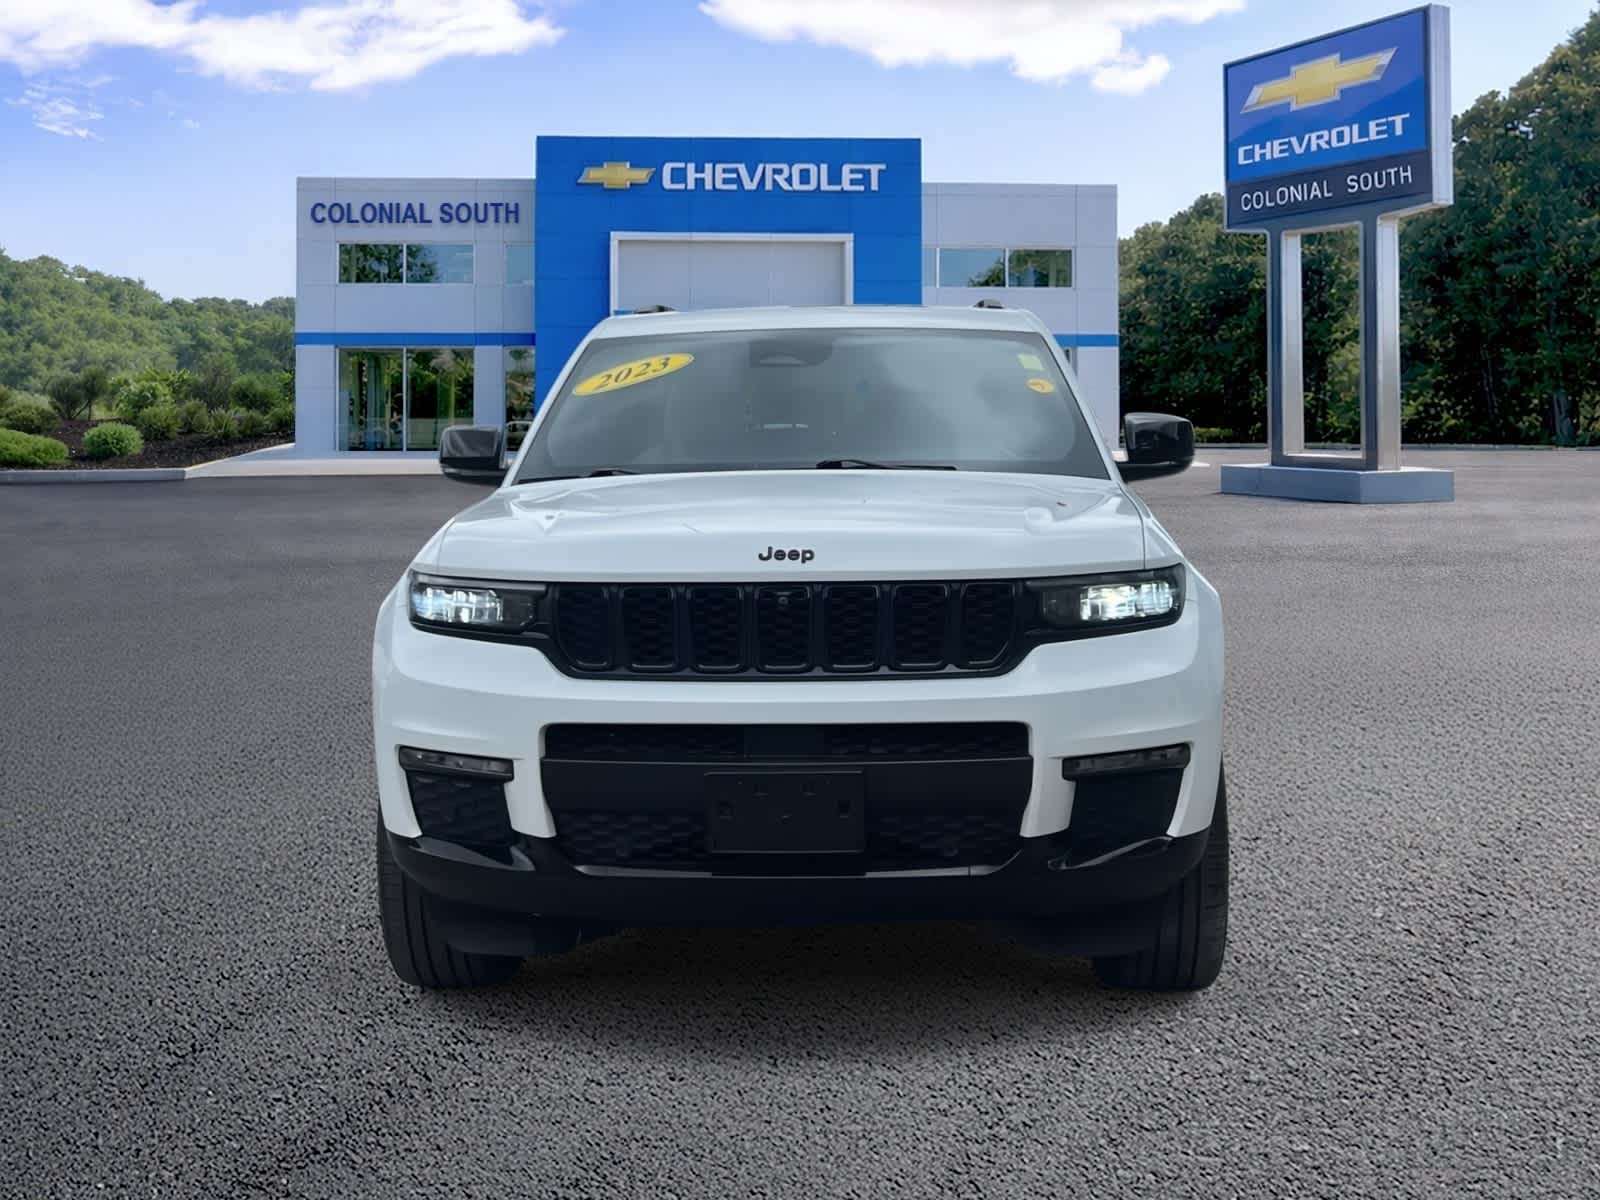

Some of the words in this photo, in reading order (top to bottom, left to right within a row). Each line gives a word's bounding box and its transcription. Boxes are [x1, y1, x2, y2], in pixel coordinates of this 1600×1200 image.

[1238, 114, 1409, 165] CHEVROLET
[661, 162, 886, 192] CHEVROLET
[1241, 180, 1333, 211] COLONIAL
[1346, 165, 1413, 193] SOUTH
[310, 202, 433, 225] COLONIAL
[439, 202, 521, 225] SOUTH
[596, 357, 671, 389] 2023
[757, 545, 816, 564] Jeep
